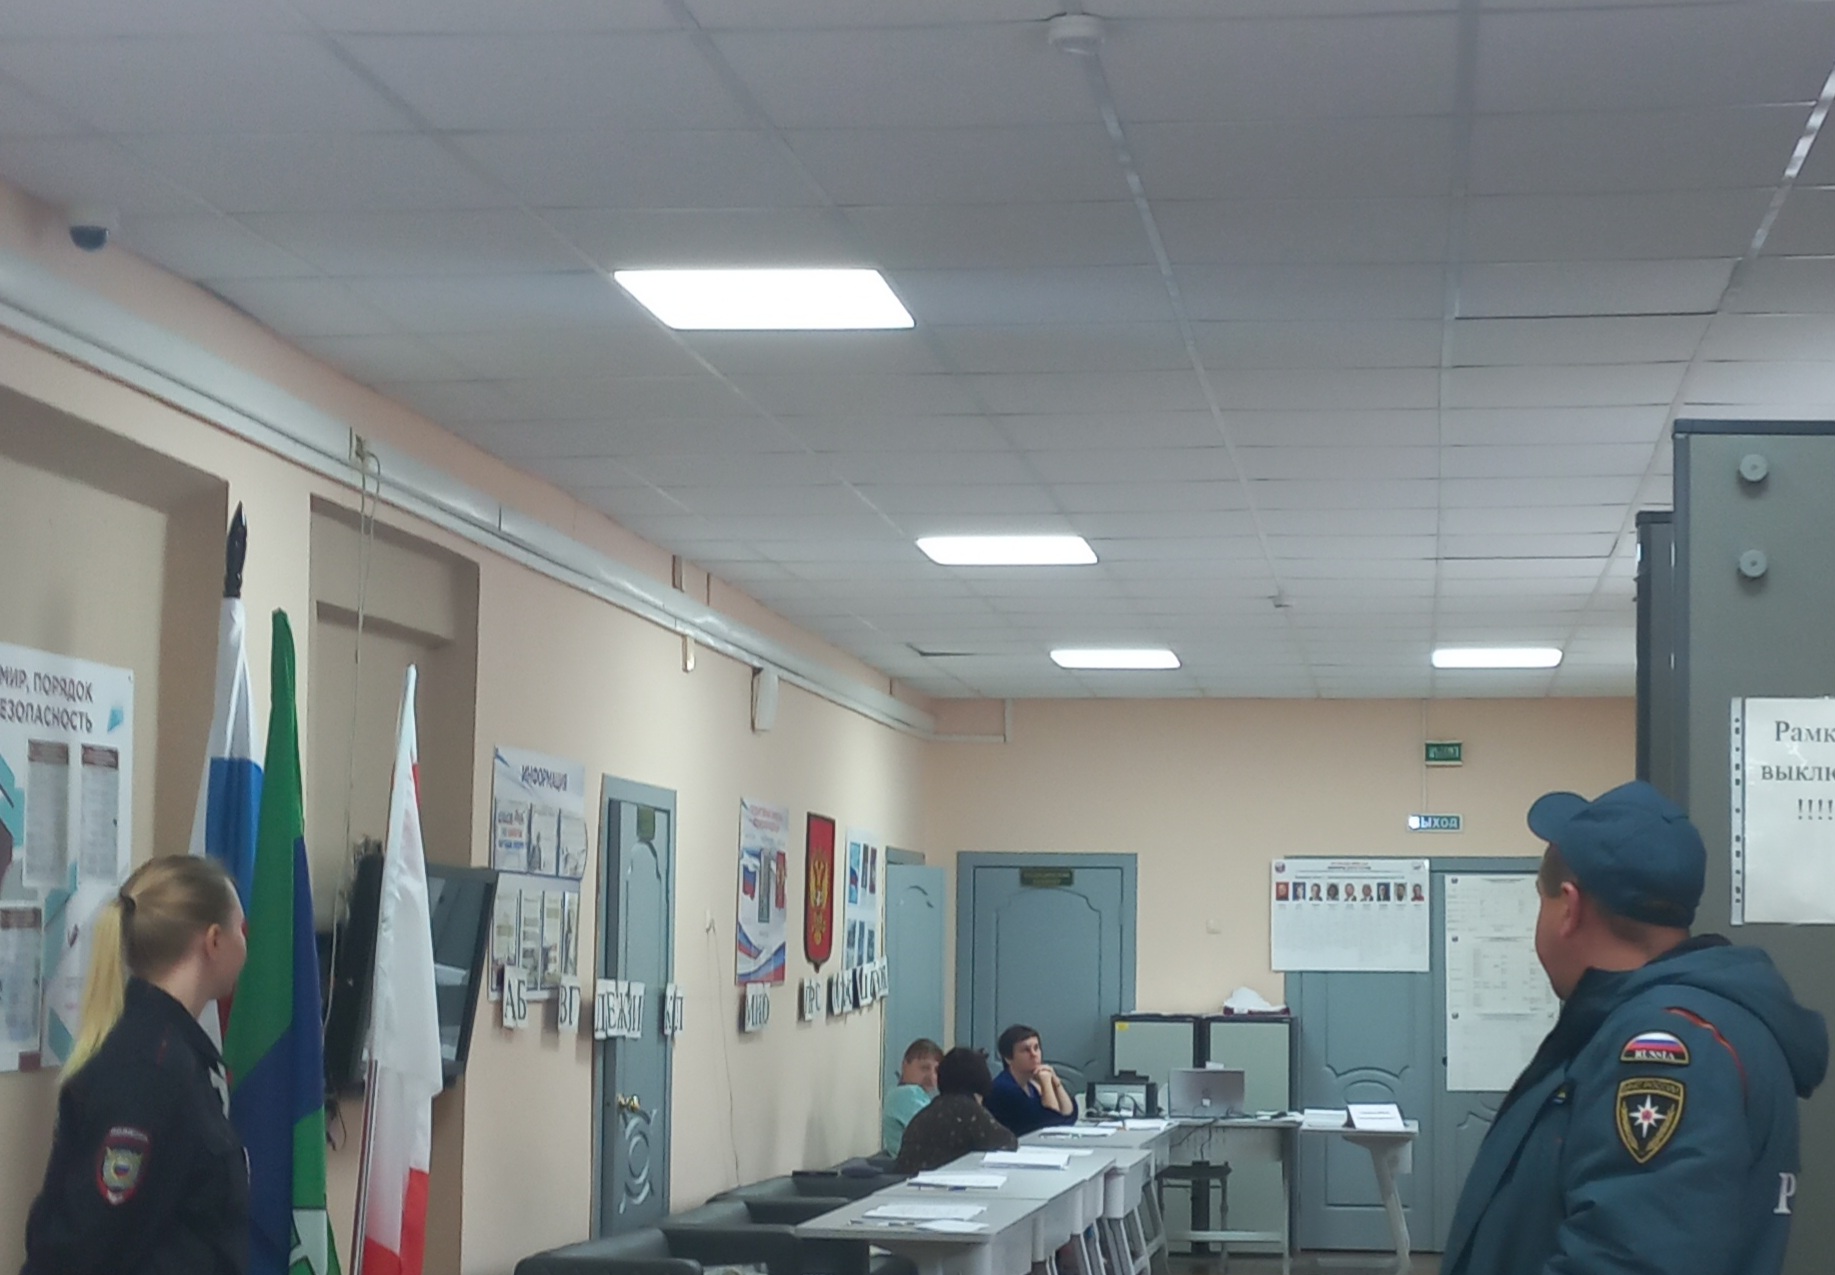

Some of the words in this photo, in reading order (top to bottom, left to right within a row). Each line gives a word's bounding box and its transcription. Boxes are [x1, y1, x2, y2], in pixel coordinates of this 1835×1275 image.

[33, 672, 93, 703] ПОРЯДОК
[1775, 720, 1835, 742] Рамк
[1409, 815, 1458, 829] ЫХОД
